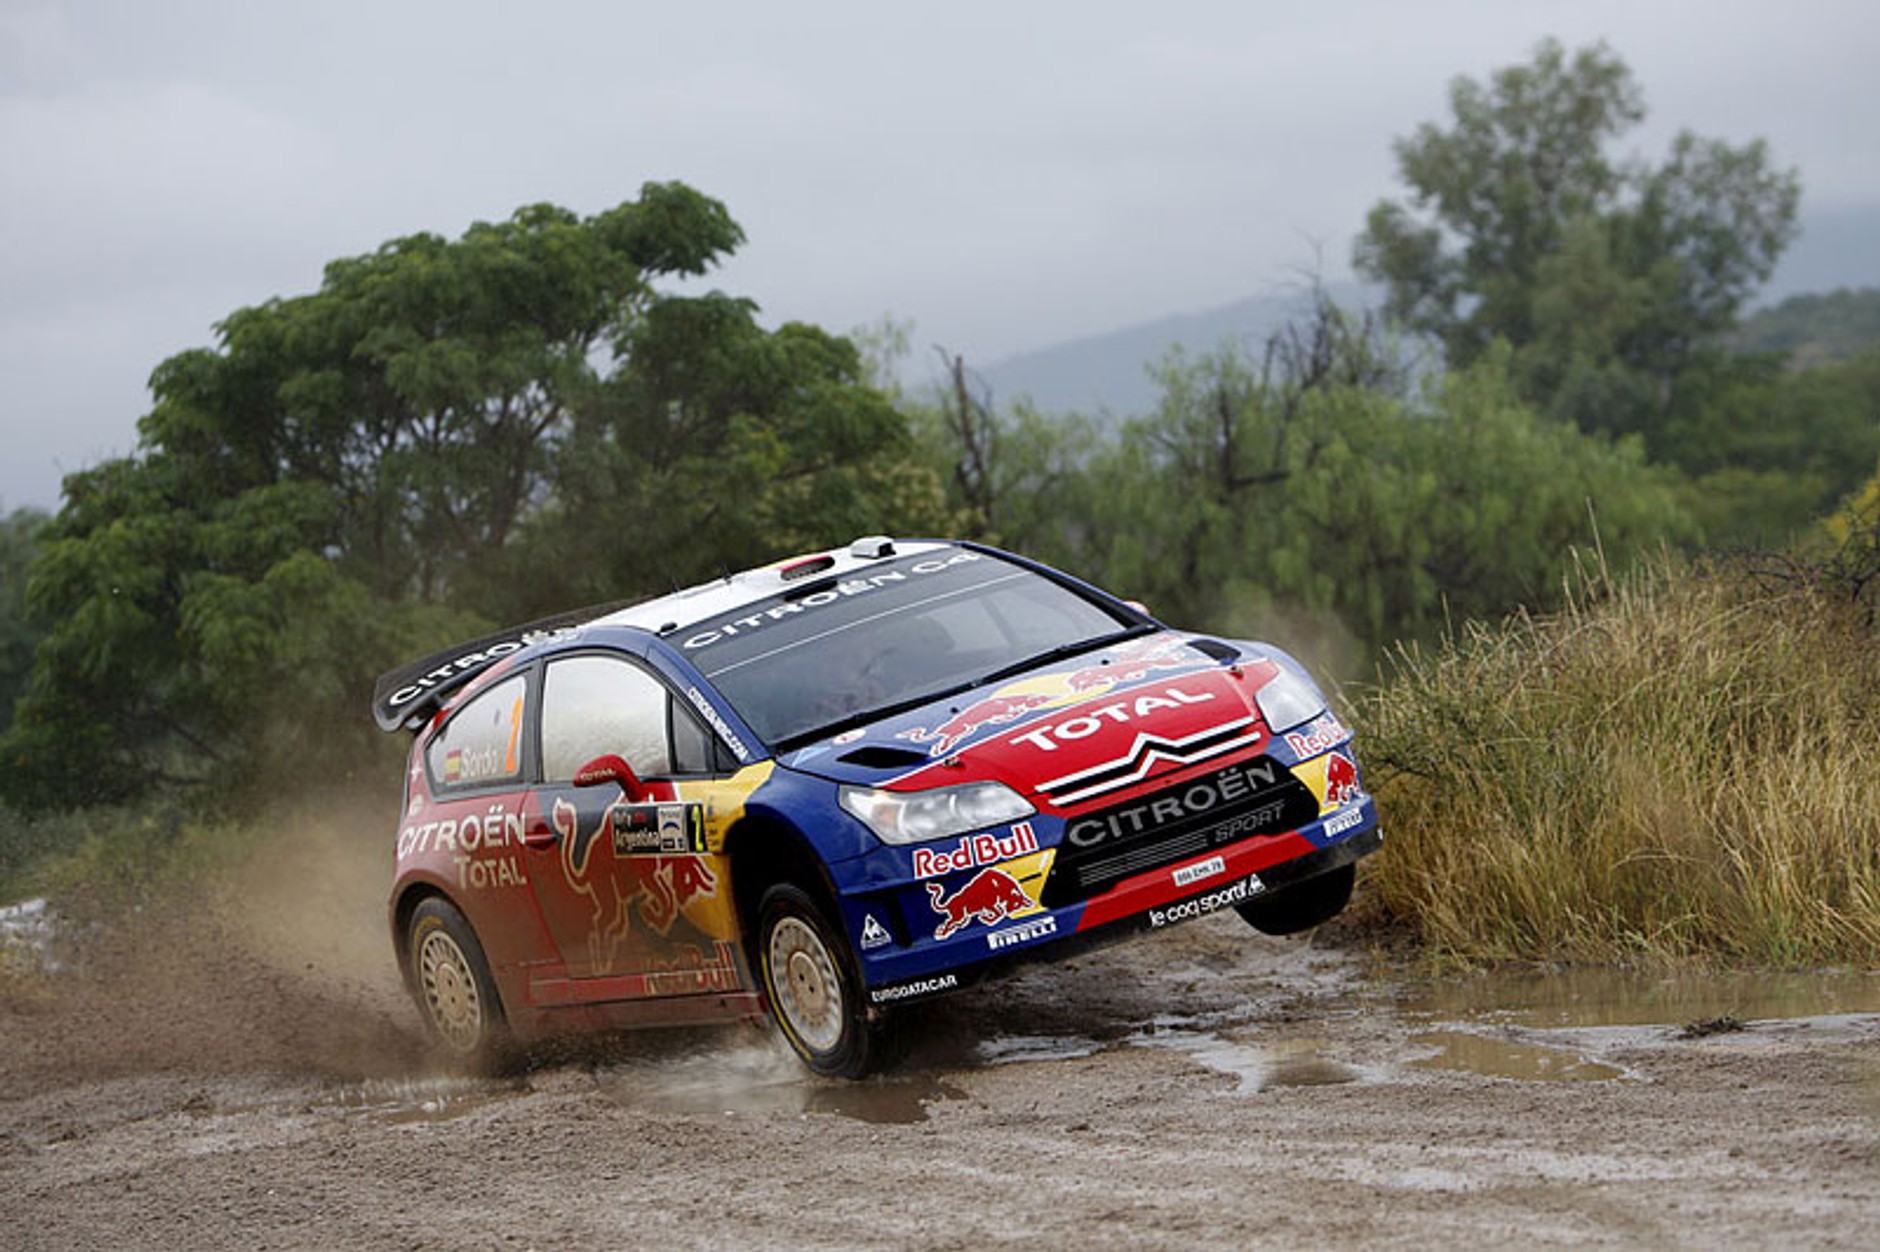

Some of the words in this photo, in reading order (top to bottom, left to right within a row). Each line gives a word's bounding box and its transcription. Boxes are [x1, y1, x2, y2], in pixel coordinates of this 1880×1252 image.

[684, 571, 906, 650] CITROËN
[911, 551, 981, 574] C4
[389, 628, 566, 706] CITRO
[1009, 686, 1216, 752] TOTAL
[397, 804, 526, 862] CITROËN
[1069, 761, 1277, 848] CITROËN
[1215, 802, 1285, 844] SPORT
[454, 855, 528, 891] TOTAL
[1148, 906, 1166, 928] le
[1166, 899, 1200, 923] coq
[1200, 878, 1248, 914] sportif
[987, 915, 1058, 950] PIRELLI
